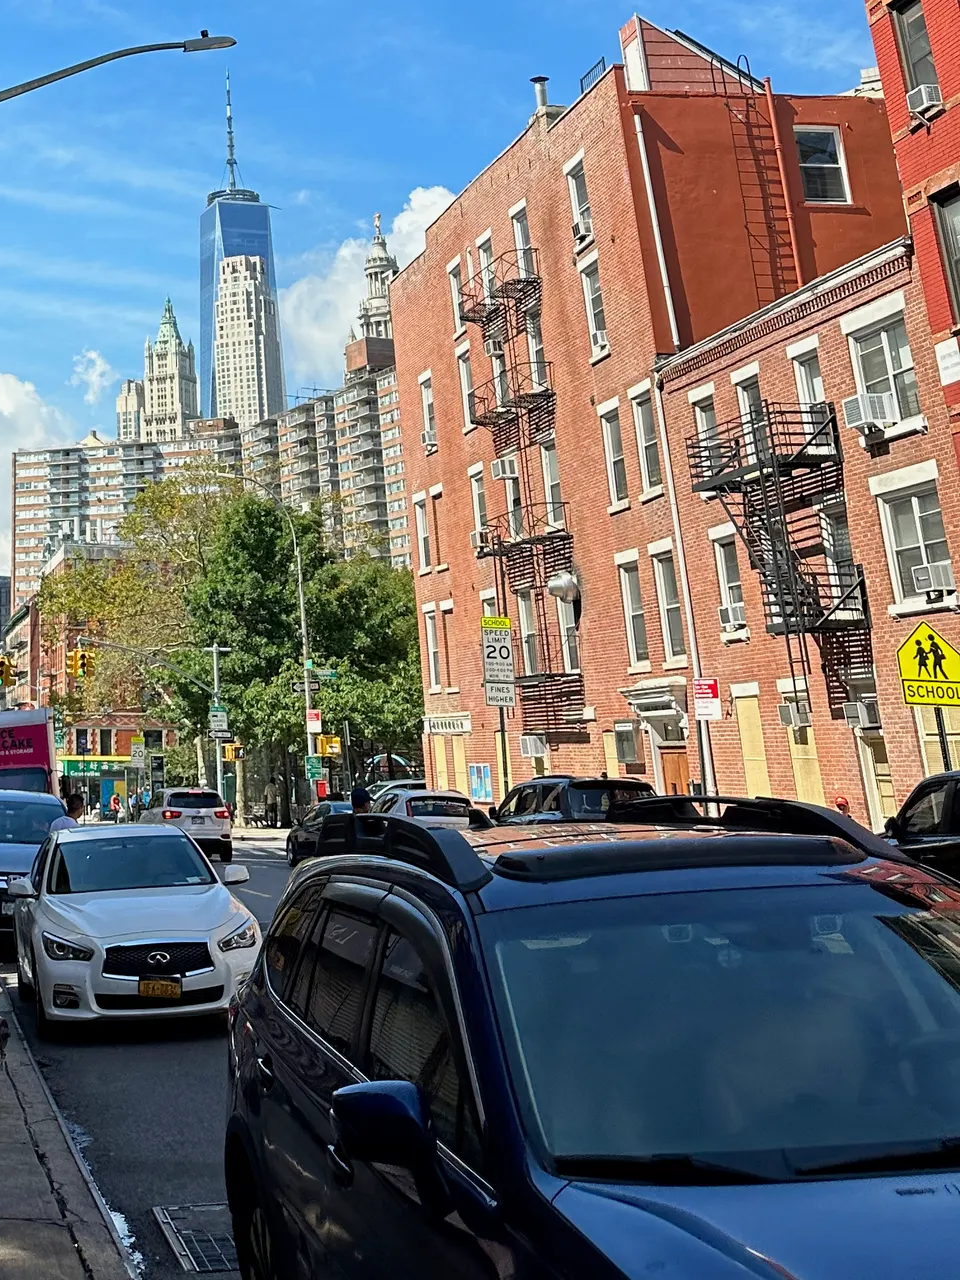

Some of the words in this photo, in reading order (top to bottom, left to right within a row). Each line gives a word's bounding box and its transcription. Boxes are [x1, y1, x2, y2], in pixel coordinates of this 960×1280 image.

[483, 619, 508, 627] SCHOOL
[485, 645, 510, 659] 20
[907, 685, 960, 700] SCHOOL
[2, 738, 33, 750] CAKE
[132, 750, 143, 758] 20
